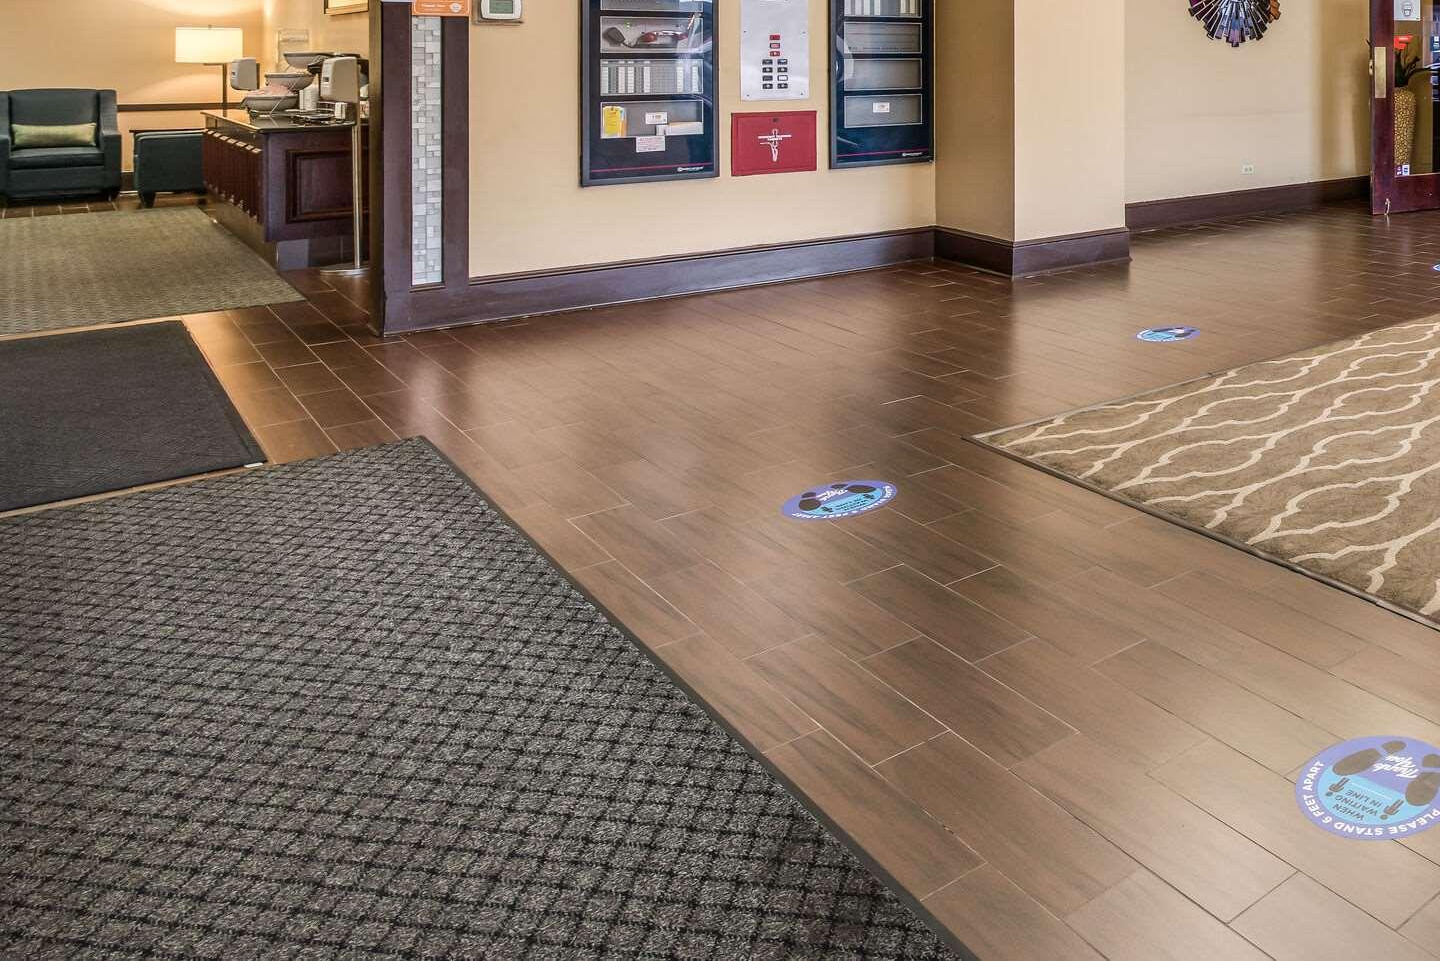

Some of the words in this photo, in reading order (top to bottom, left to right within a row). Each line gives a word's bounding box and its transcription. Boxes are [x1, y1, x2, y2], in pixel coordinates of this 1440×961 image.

[1302, 761, 1325, 792] APART
[1371, 762, 1419, 779] Thank
[1344, 789, 1370, 803] LINE
[1369, 799, 1384, 808] IN
[1303, 794, 1325, 817] FEET
[1332, 803, 1365, 821] WHEN
[1334, 795, 1379, 816] WAITING
[1321, 815, 1333, 824] 6
[1333, 822, 1384, 836] STAND
